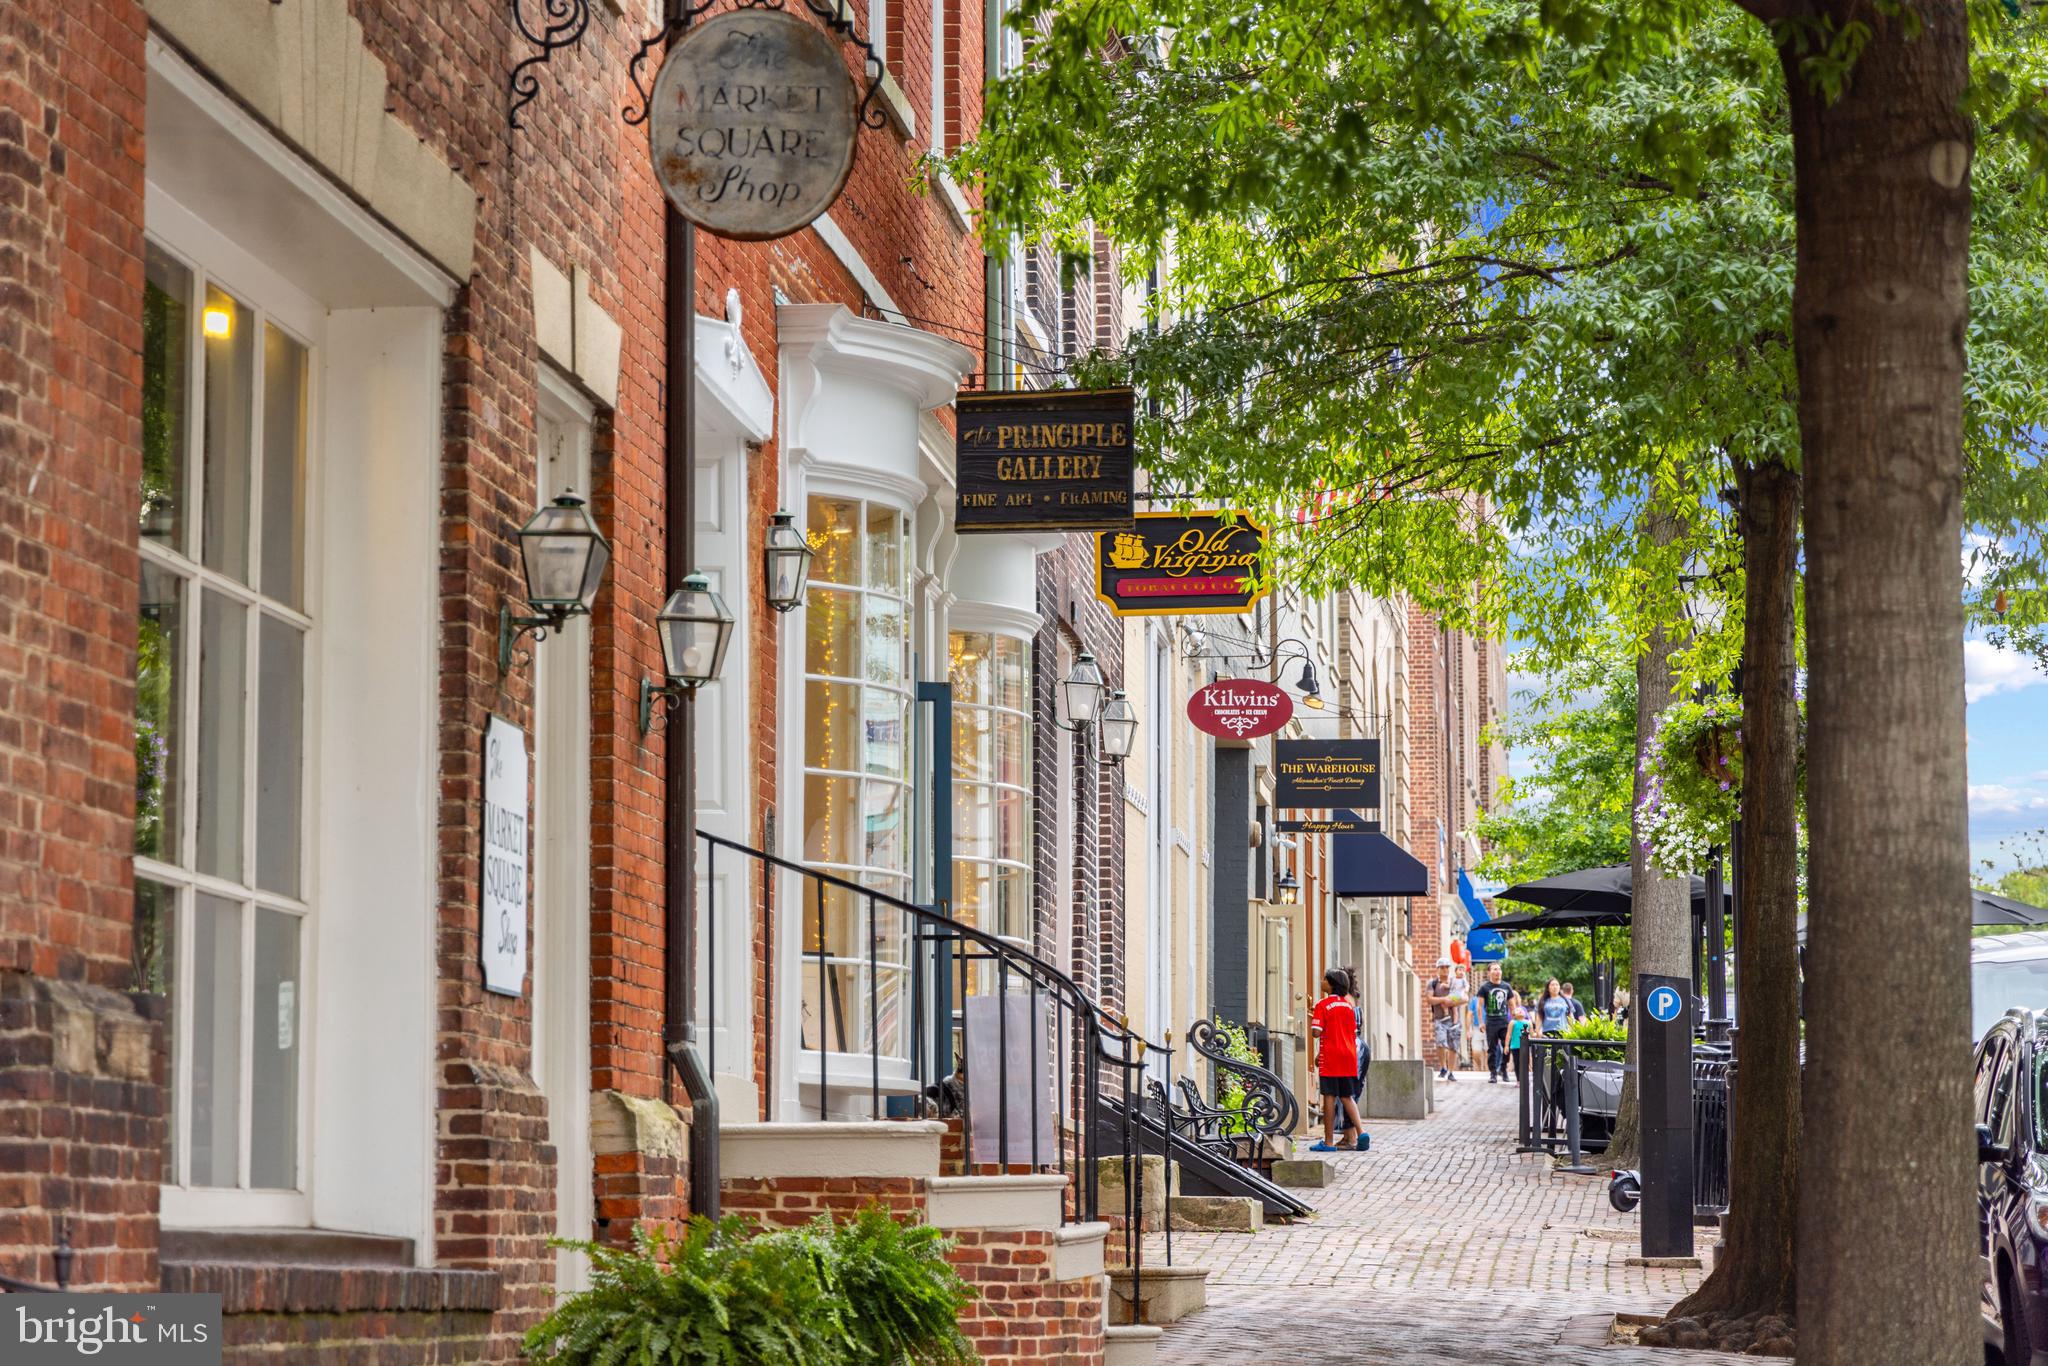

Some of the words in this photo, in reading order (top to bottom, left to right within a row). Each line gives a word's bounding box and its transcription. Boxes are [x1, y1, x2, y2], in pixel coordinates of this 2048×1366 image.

[676, 84, 830, 113] MARKET
[676, 127, 829, 158] SQUARE
[697, 164, 801, 208] Shop
[963, 425, 992, 448] The
[997, 423, 1127, 448] PRINCIPLE
[997, 455, 1103, 480] GALLERY
[962, 493, 997, 506] FINE
[1005, 493, 1033, 506] ART
[1060, 490, 1128, 505] FRAMING
[1179, 525, 1248, 553] Old
[1153, 544, 1257, 577] Virginia
[1203, 689, 1278, 706] Kilwins
[1281, 763, 1303, 773] THE
[1306, 763, 1376, 773] WAREHOUSE
[487, 801, 524, 856] MARKET
[1301, 822, 1331, 832] Happy
[1331, 822, 1355, 830] Hour
[487, 856, 523, 907] SQUARE
[1658, 993, 1673, 1016] P
